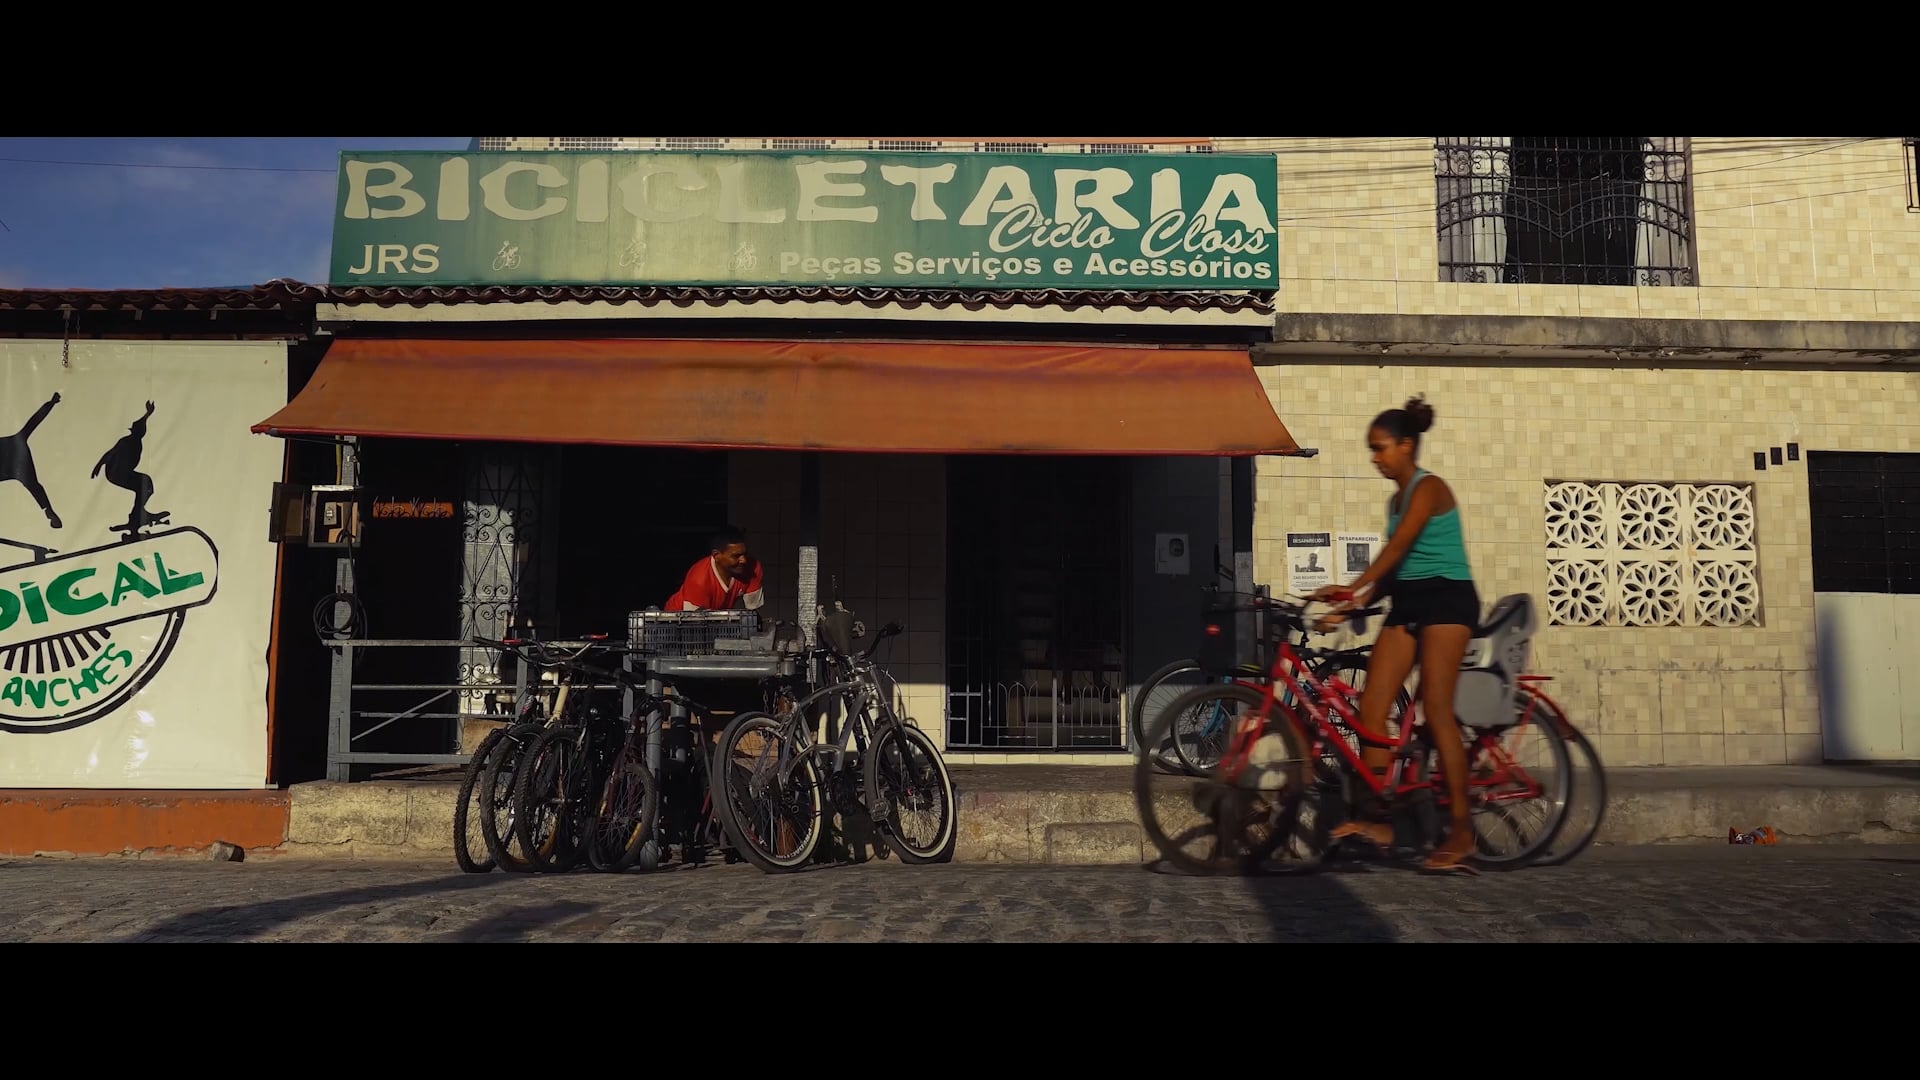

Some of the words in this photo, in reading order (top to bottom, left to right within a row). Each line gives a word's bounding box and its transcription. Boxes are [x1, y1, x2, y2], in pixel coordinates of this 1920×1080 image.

[344, 157, 1277, 234] BICICLETARIA
[988, 204, 1116, 253] Ciclo
[348, 243, 440, 275] JRS
[780, 252, 882, 280] Peças
[892, 252, 1042, 281] Serviços
[1052, 258, 1074, 275] e
[1084, 253, 1272, 280] Acessórios
